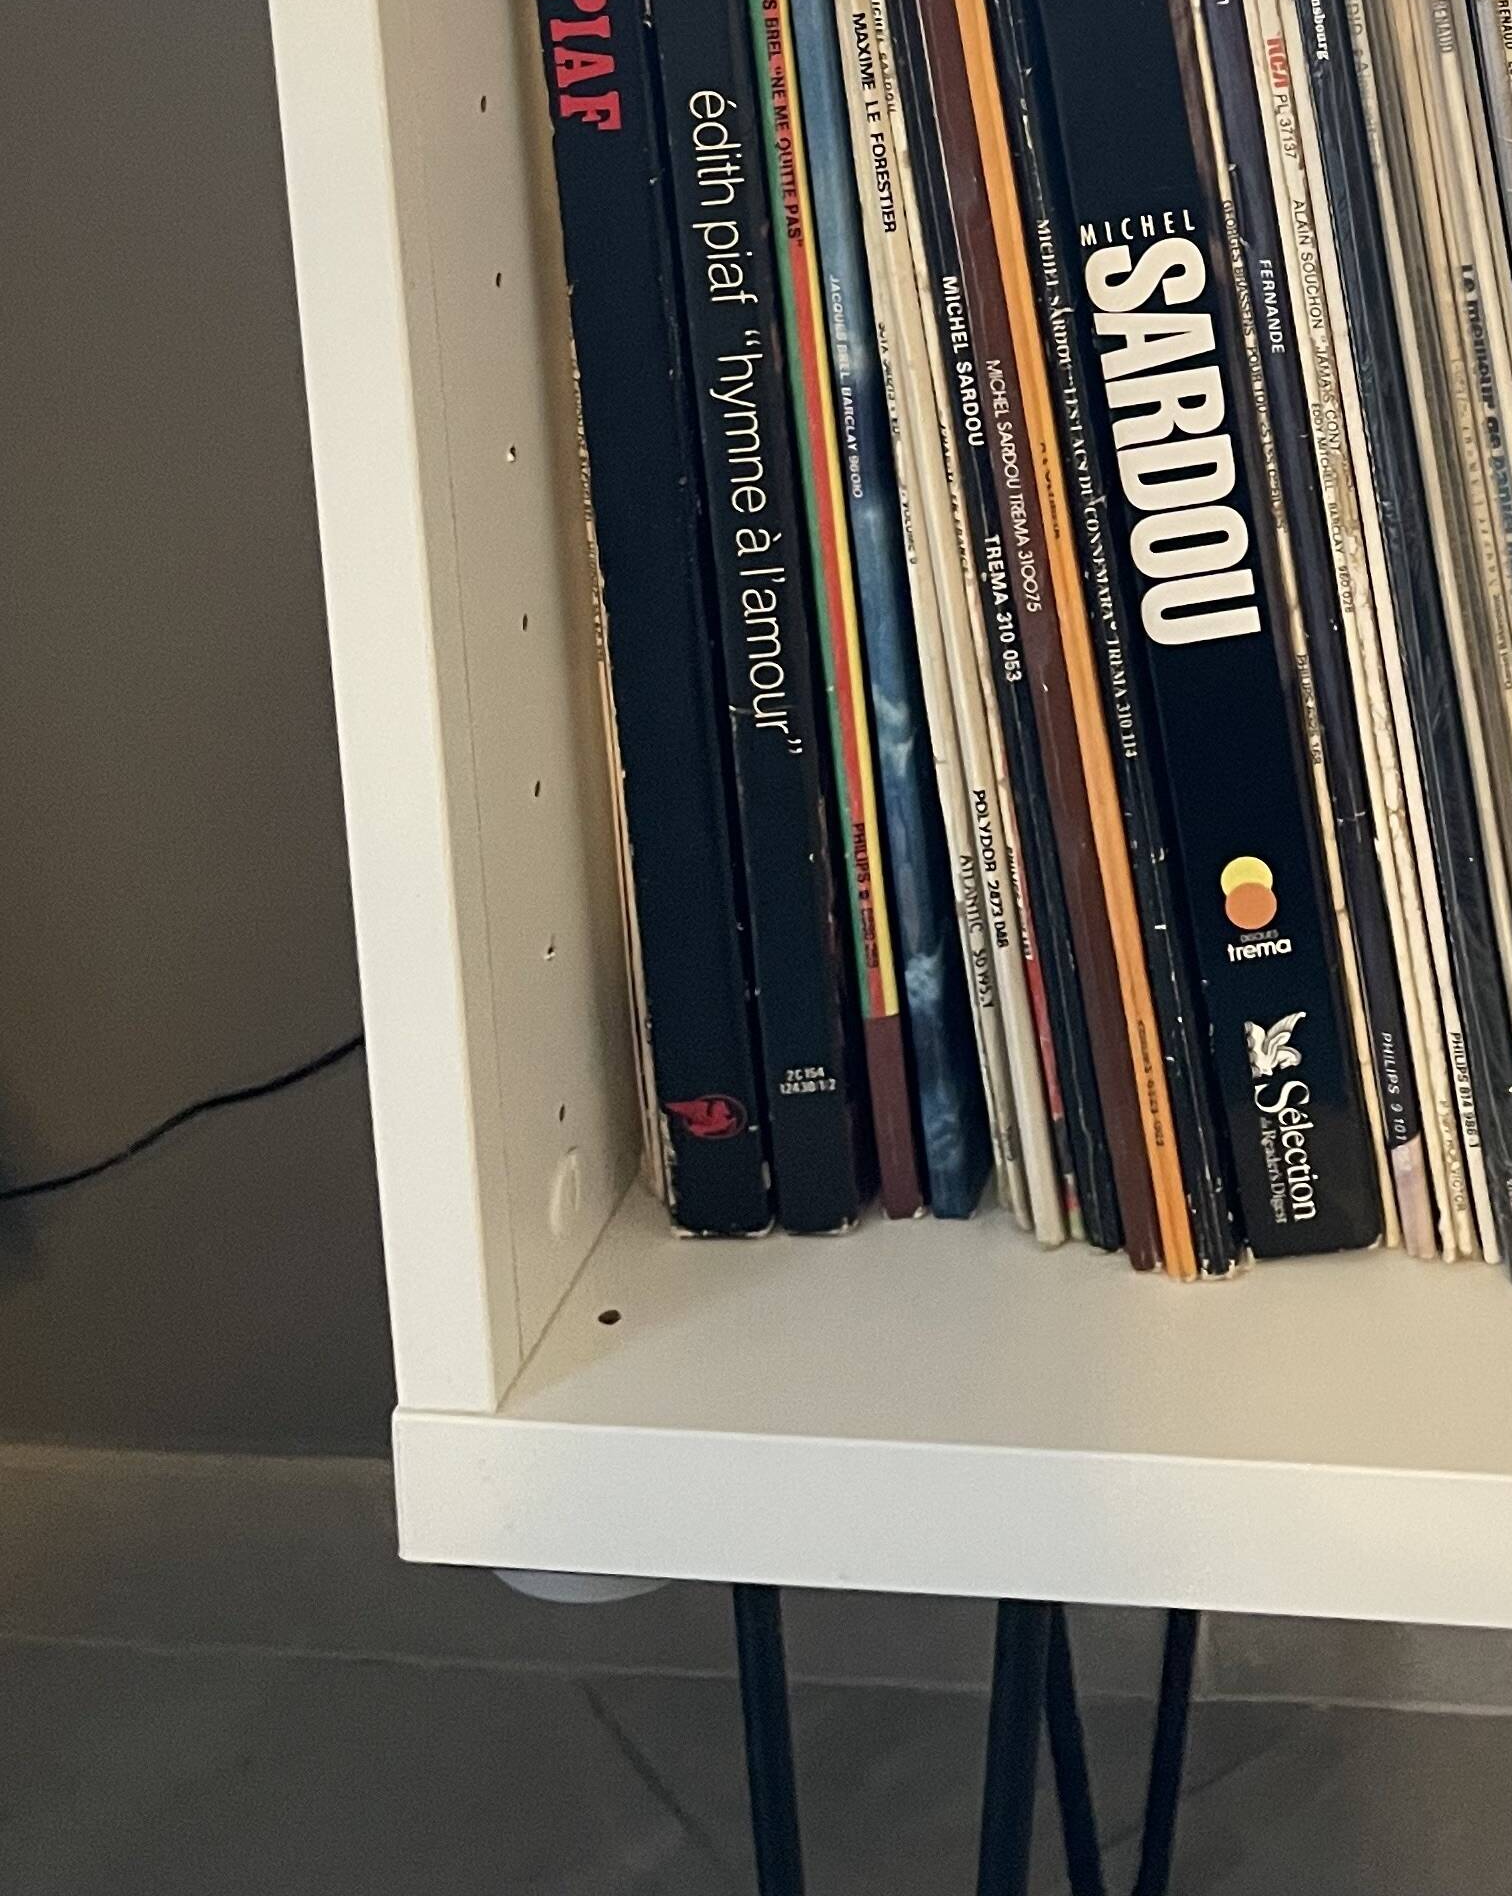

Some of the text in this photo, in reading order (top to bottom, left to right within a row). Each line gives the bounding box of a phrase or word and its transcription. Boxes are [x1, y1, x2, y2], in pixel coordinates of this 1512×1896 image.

[762, 16, 782, 60] BREL
[772, 104, 789, 132] ME
[685, 86, 748, 206] édith
[851, 12, 897, 234] MAXIME LE FORESTIER
[1080, 209, 1196, 247] MICHEL
[1265, 36, 1324, 329] RCA PL 37137 ALAIN SOUCHON
[692, 217, 759, 308] piaf
[1036, 218, 1059, 286] MICHEL
[1257, 258, 1285, 354] FERNANDE
[840, 386, 859, 451] BARCLAY
[1085, 236, 1262, 647] SARDOU
[941, 274, 1021, 683] MICHEL SARDOU TREMA 310 053
[986, 359, 1041, 613] MICHEL SARDOU TREMA 310075
[1310, 402, 1343, 553] EDDY MITCHELL BARCLAY
[736, 524, 783, 557] à
[1106, 638, 1127, 697] TREMA
[1116, 702, 1132, 728] 310
[849, 821, 870, 883] PHILIPS
[972, 789, 997, 873] POLYDOR
[959, 853, 984, 933] ATLANTIC
[1228, 937, 1292, 962] trema
[1379, 1031, 1400, 1094] PHILIPS
[1393, 1116, 1408, 1142] 101
[1449, 1031, 1469, 1083] PHILIPS
[1254, 1079, 1319, 1222] Sélection
